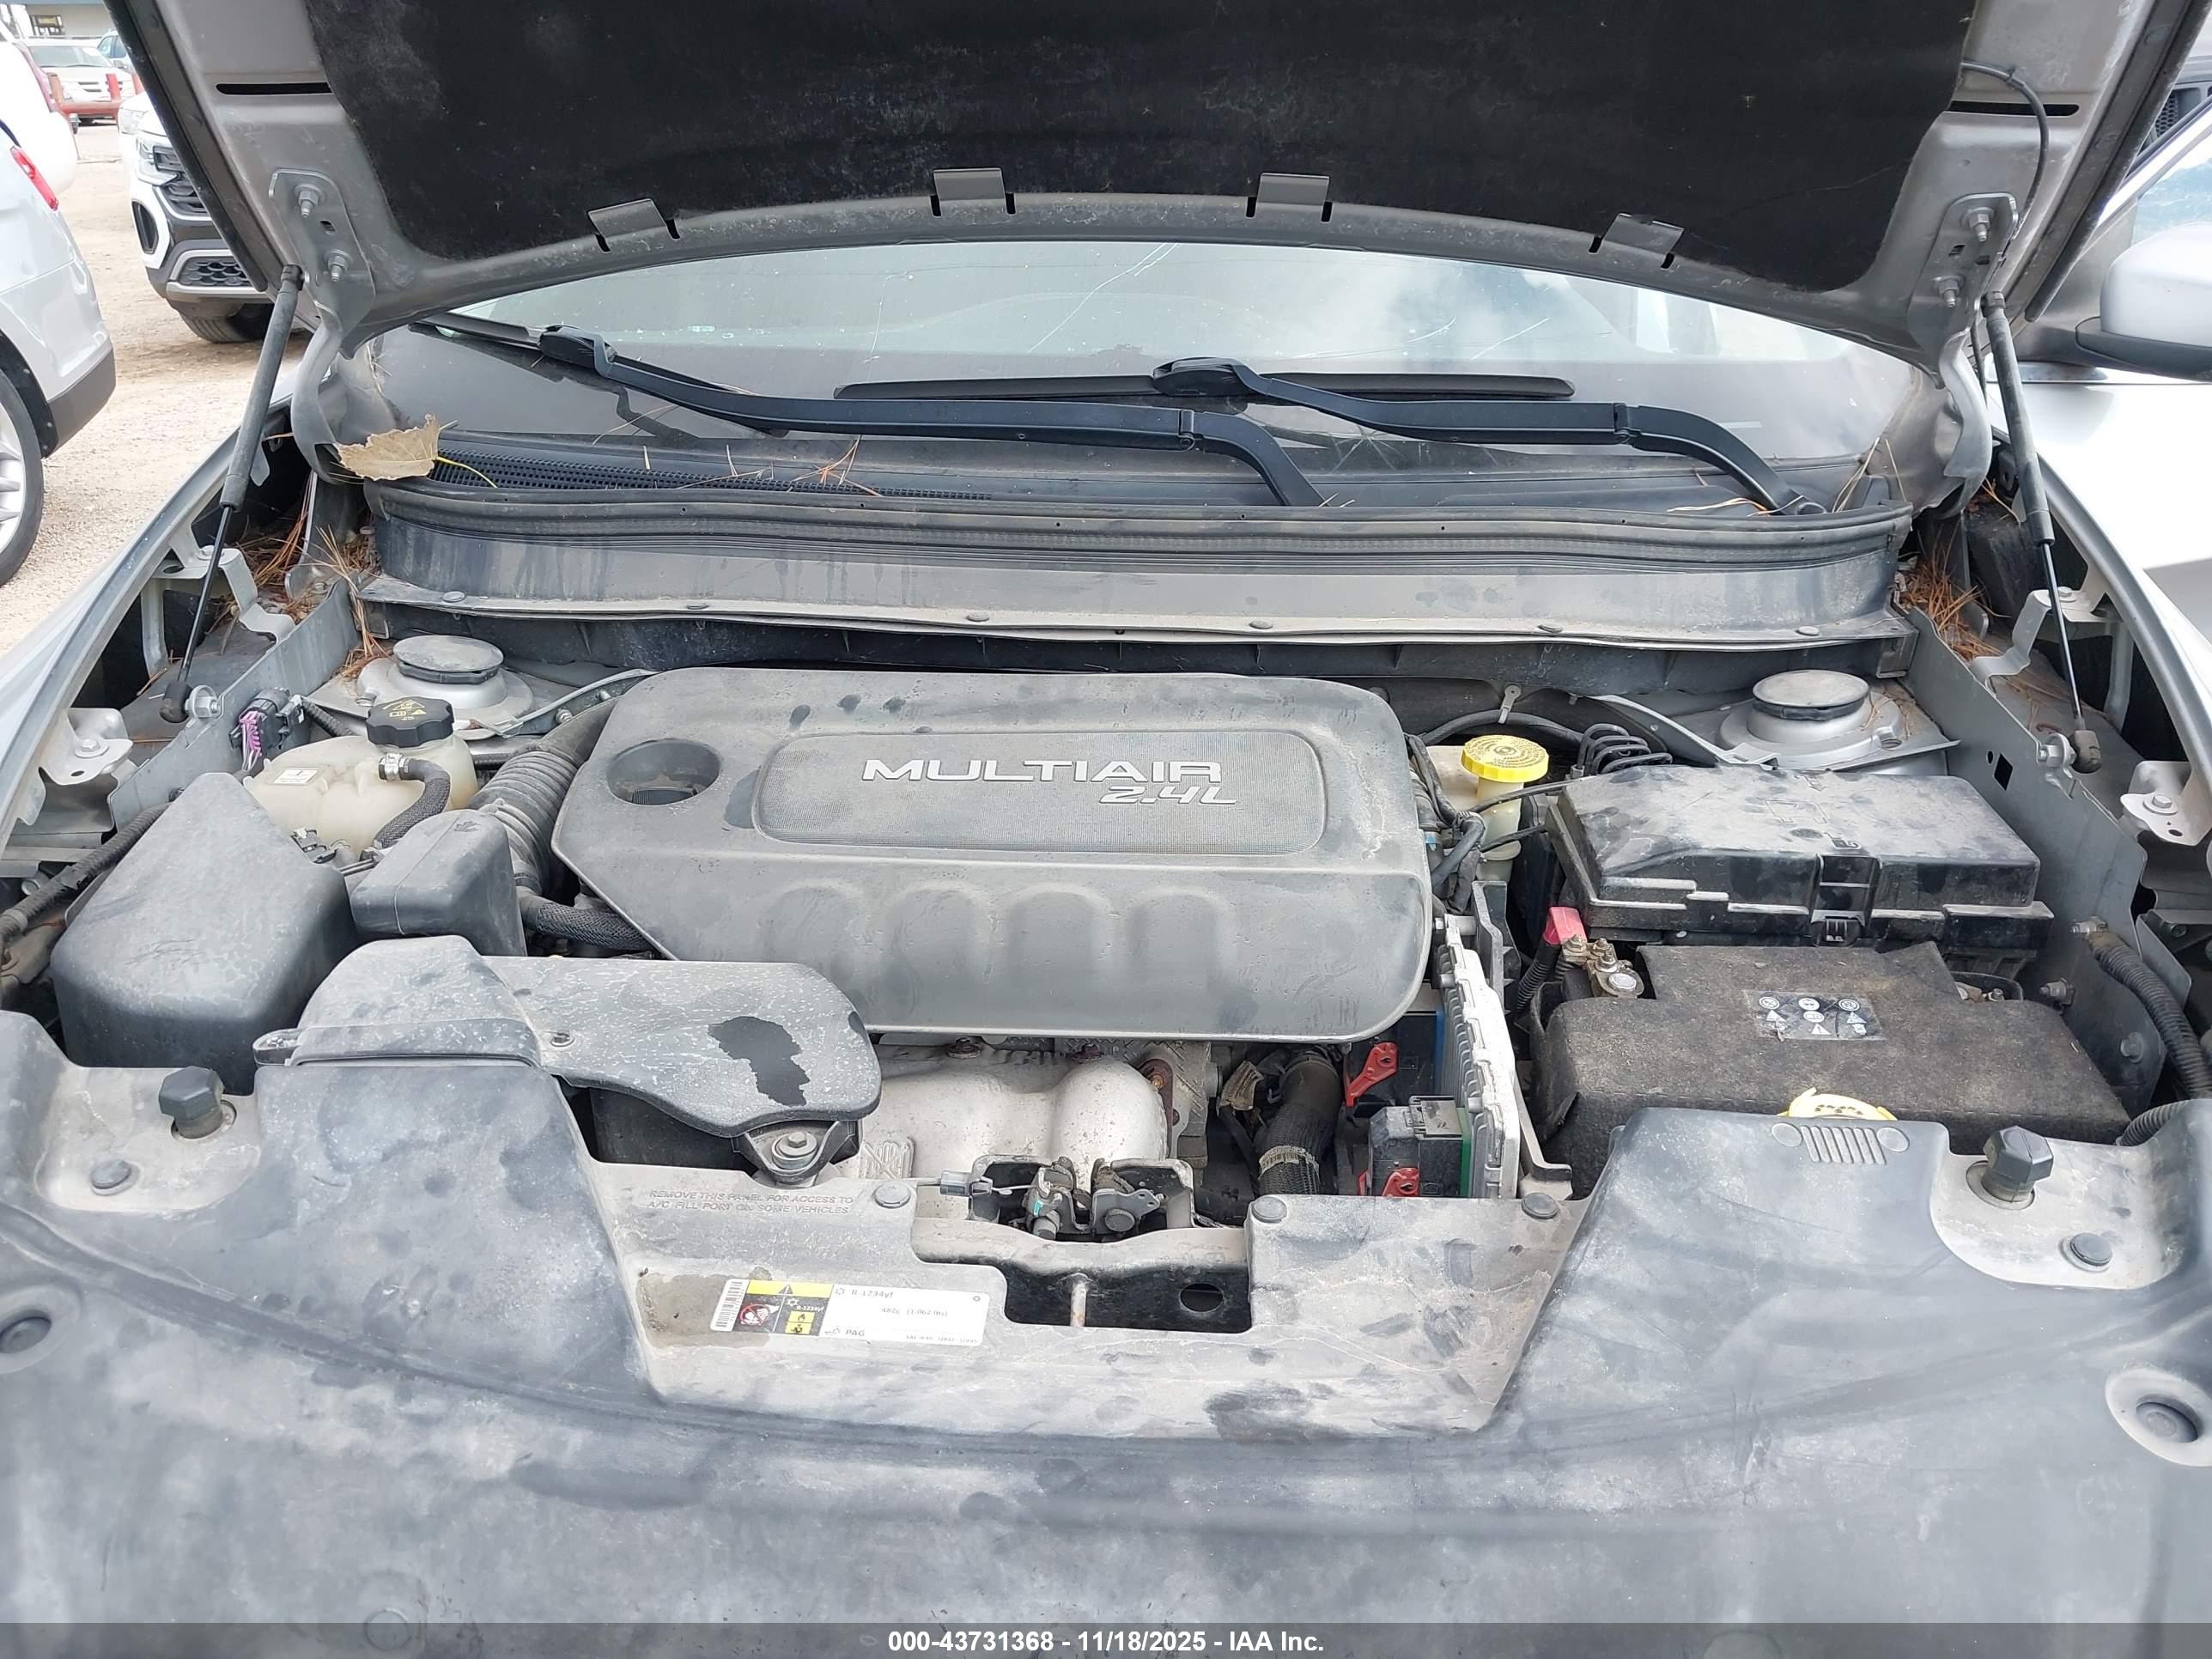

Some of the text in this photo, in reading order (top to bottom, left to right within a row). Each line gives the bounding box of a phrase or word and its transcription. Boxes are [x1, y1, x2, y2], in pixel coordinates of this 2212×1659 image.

[861, 759, 1222, 783] MULTIAIR
[1099, 785, 1237, 805] 2.4L
[649, 1190, 854, 1205] REMOVE THIS PANEL FOR ACCESS TO
[647, 1200, 850, 1214] A/C FILL PORT ON SOME VEHICLES
[846, 1328, 866, 1337] PAG
